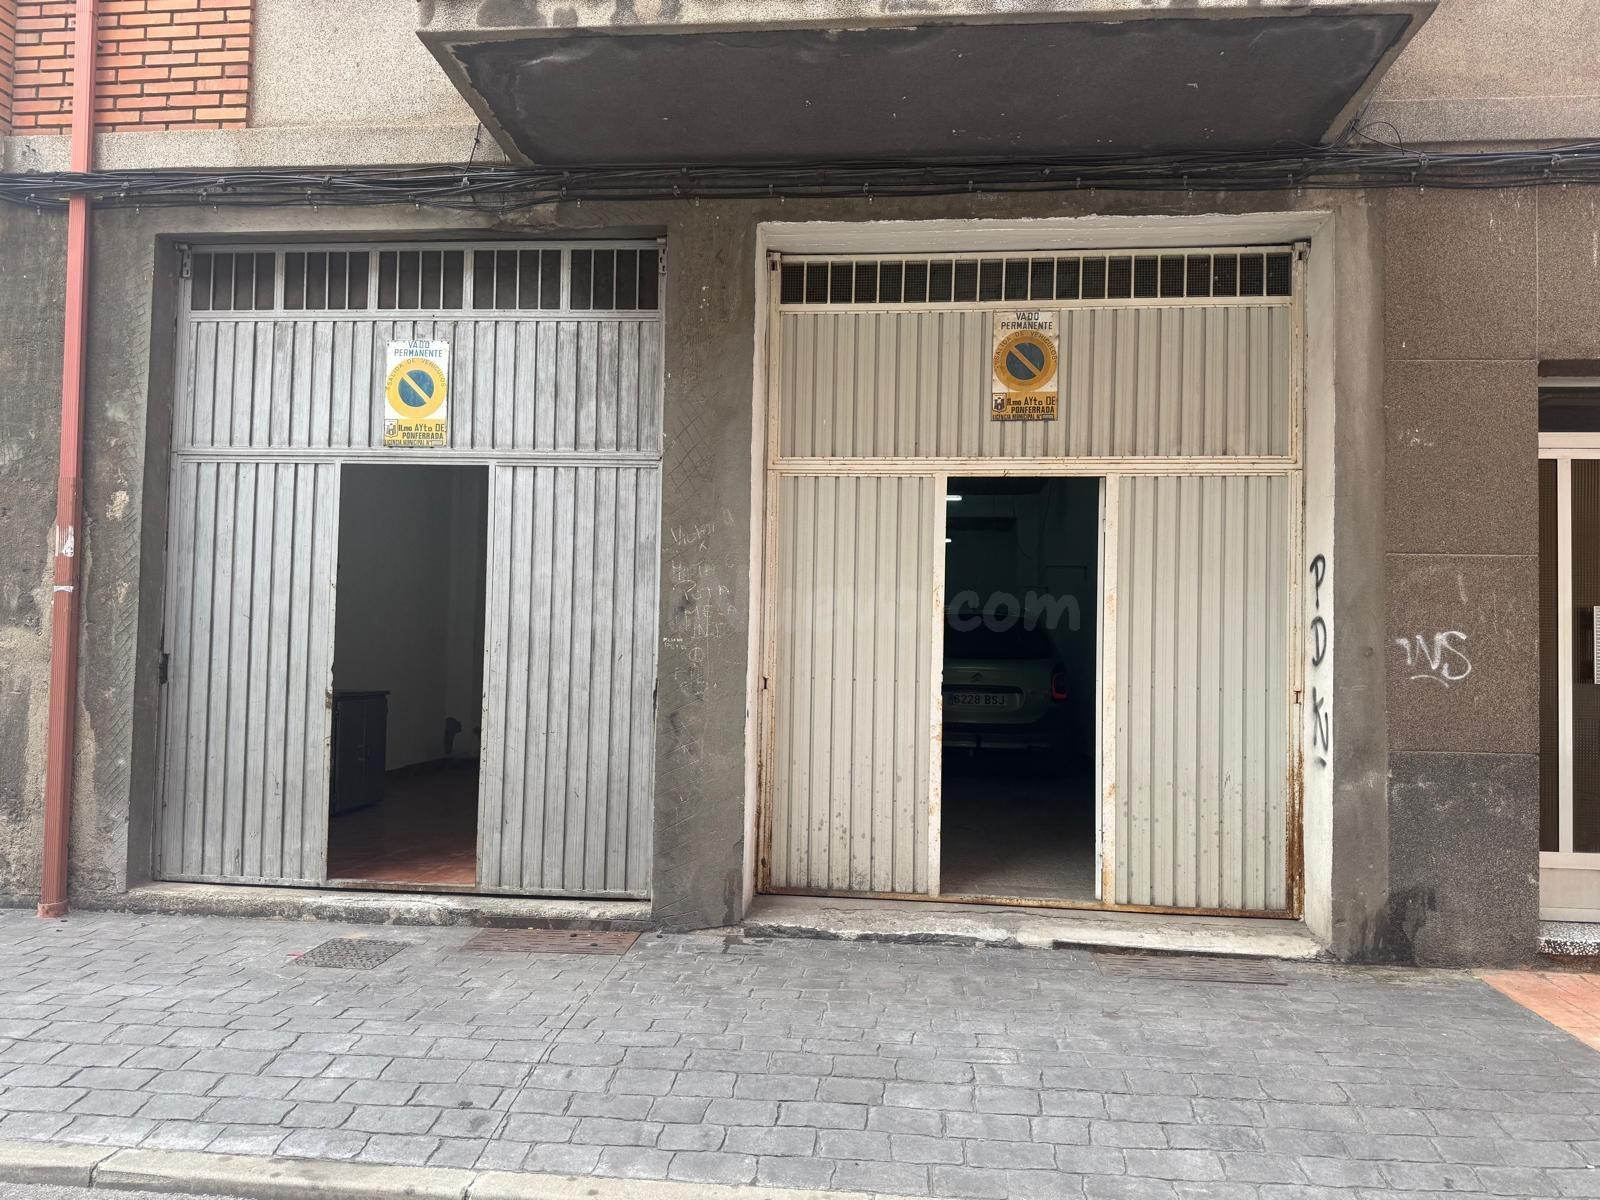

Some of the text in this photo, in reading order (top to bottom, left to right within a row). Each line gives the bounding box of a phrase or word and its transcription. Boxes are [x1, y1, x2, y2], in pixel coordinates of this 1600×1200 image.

[1015, 312, 1040, 320] VADO
[1000, 321, 1053, 330] PERMANENTE
[408, 340, 430, 349] VADO
[994, 337, 1011, 360] SALIDA
[1030, 331, 1057, 360] VEHICULOS
[394, 348, 443, 358] PERMANENTE
[387, 364, 404, 386] SALIDA
[420, 358, 446, 386] VEHICULOS
[1045, 396, 1056, 406] DE
[435, 423, 445, 432] DE
[402, 432, 444, 440] PONFERRADA
[984, 694, 1005, 705] BSJ
